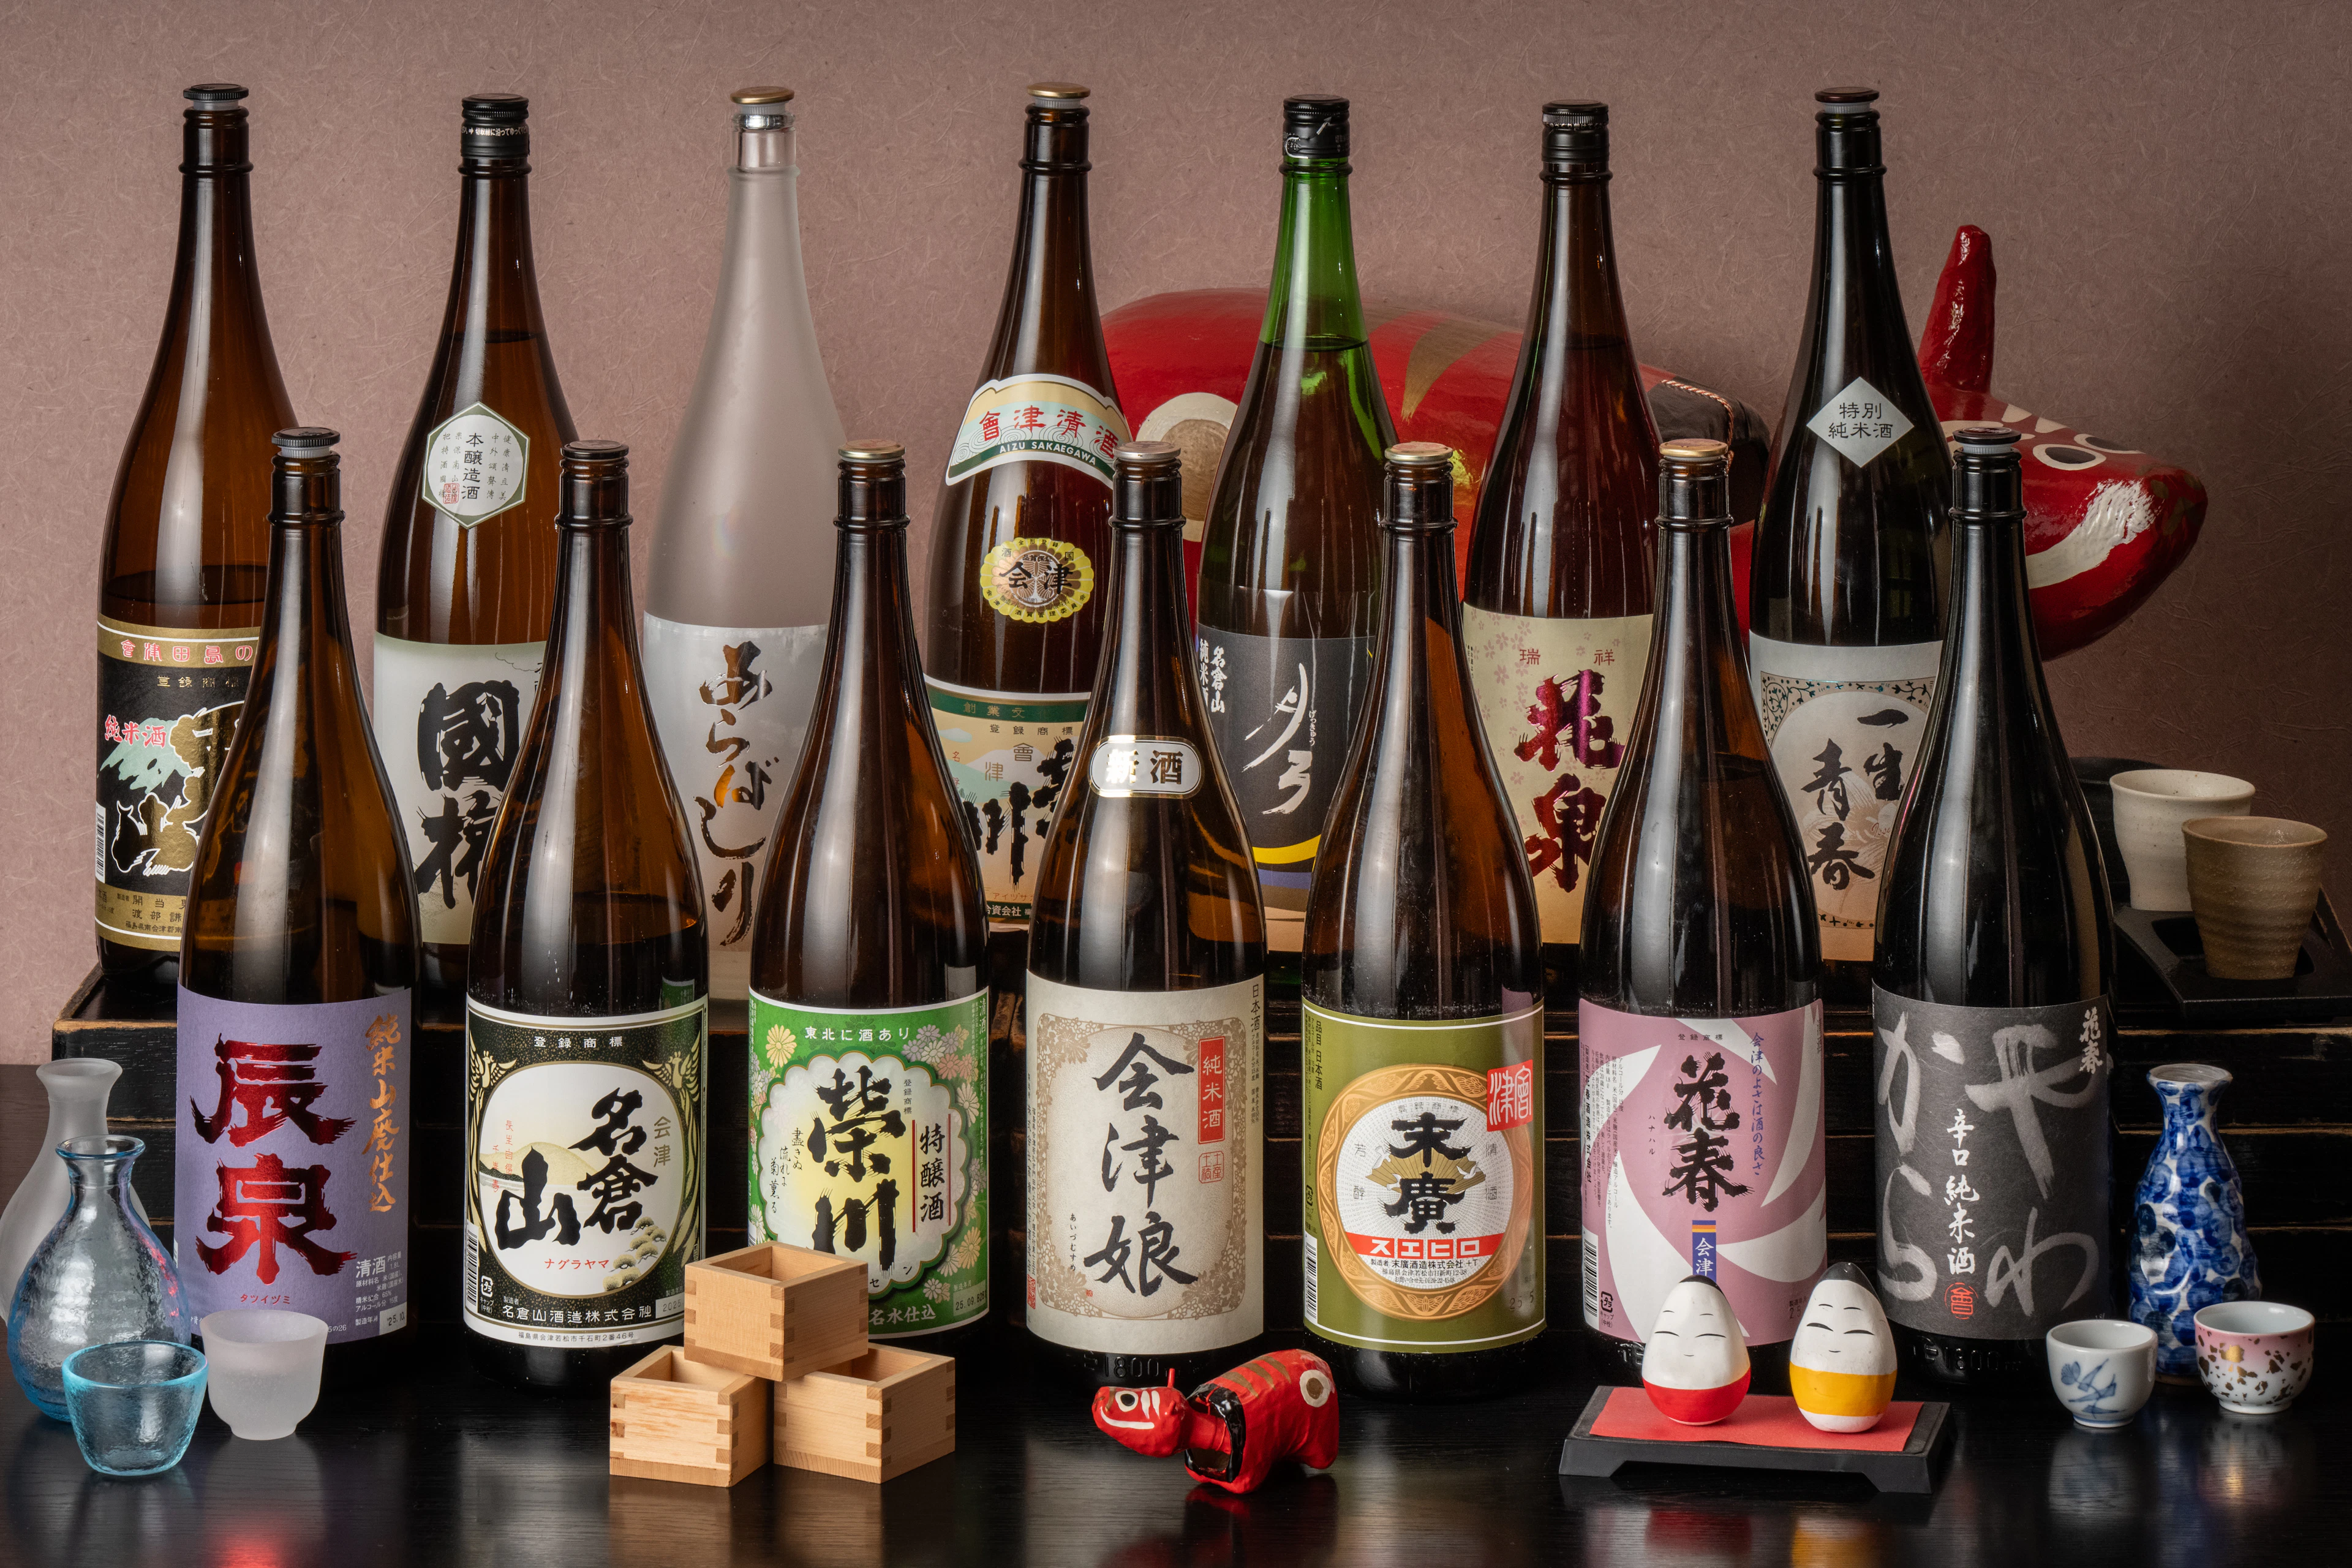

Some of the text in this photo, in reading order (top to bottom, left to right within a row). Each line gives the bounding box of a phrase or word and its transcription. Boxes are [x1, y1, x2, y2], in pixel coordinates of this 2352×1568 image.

[1839, 402, 1882, 420] 特別
[979, 405, 1120, 460] 會津清酒
[1828, 422, 1893, 440] 純米酒
[461, 432, 484, 500] 本醸造酒
[1000, 440, 1097, 466] AIZU SAKAEGAWA
[999, 561, 1074, 595] 会津
[1210, 646, 1227, 714] 名倉山
[104, 714, 167, 748] 純米酒
[989, 724, 1074, 736] 登録商標
[1308, 709, 1317, 747] げっきゅう
[1856, 709, 1909, 801] 一生
[693, 640, 780, 947] あらばしり
[1801, 737, 1875, 891] 青春
[979, 997, 986, 1035] 清酒
[1250, 984, 1261, 1033] 日本酒
[533, 1035, 624, 1049] 登録商標
[804, 1026, 910, 1042] 東北に酒あり
[2079, 1006, 2103, 1075] 花春
[1314, 1020, 1323, 1091] 品目 日本酒
[903, 1078, 913, 1115] 登録商標
[1201, 1054, 1223, 1129] 純米酒
[1749, 1031, 1765, 1176] 会津のよさは酒の良さ
[653, 1116, 671, 1169] 会津
[1661, 1050, 1756, 1213] 花春
[190, 1032, 358, 1286] 辰泉
[494, 1087, 659, 1250] 名倉山
[1083, 1031, 1199, 1297] 会津娘
[1376, 1111, 1476, 1235] 末廣
[1943, 1107, 1980, 1276] 辛口純米酒
[543, 1257, 610, 1270] ナグラヤマ
[1370, 1238, 1480, 1257] スエヒロ
[1370, 1258, 1389, 1267] 製造者
[1391, 1259, 1464, 1270] 末廣酒造株式会社
[1694, 1237, 1714, 1276] 会津
[356, 1255, 386, 1279] 清酒
[239, 1293, 291, 1305] タツイヅミ
[355, 1299, 387, 1313] アルコール分
[502, 1305, 652, 1324] 名倉山酒造株式会社
[503, 1295, 519, 1306] 製造者
[869, 1303, 937, 1326] 名水仕込
[518, 1331, 635, 1343] 福島県会津若松市千石町2番46号
